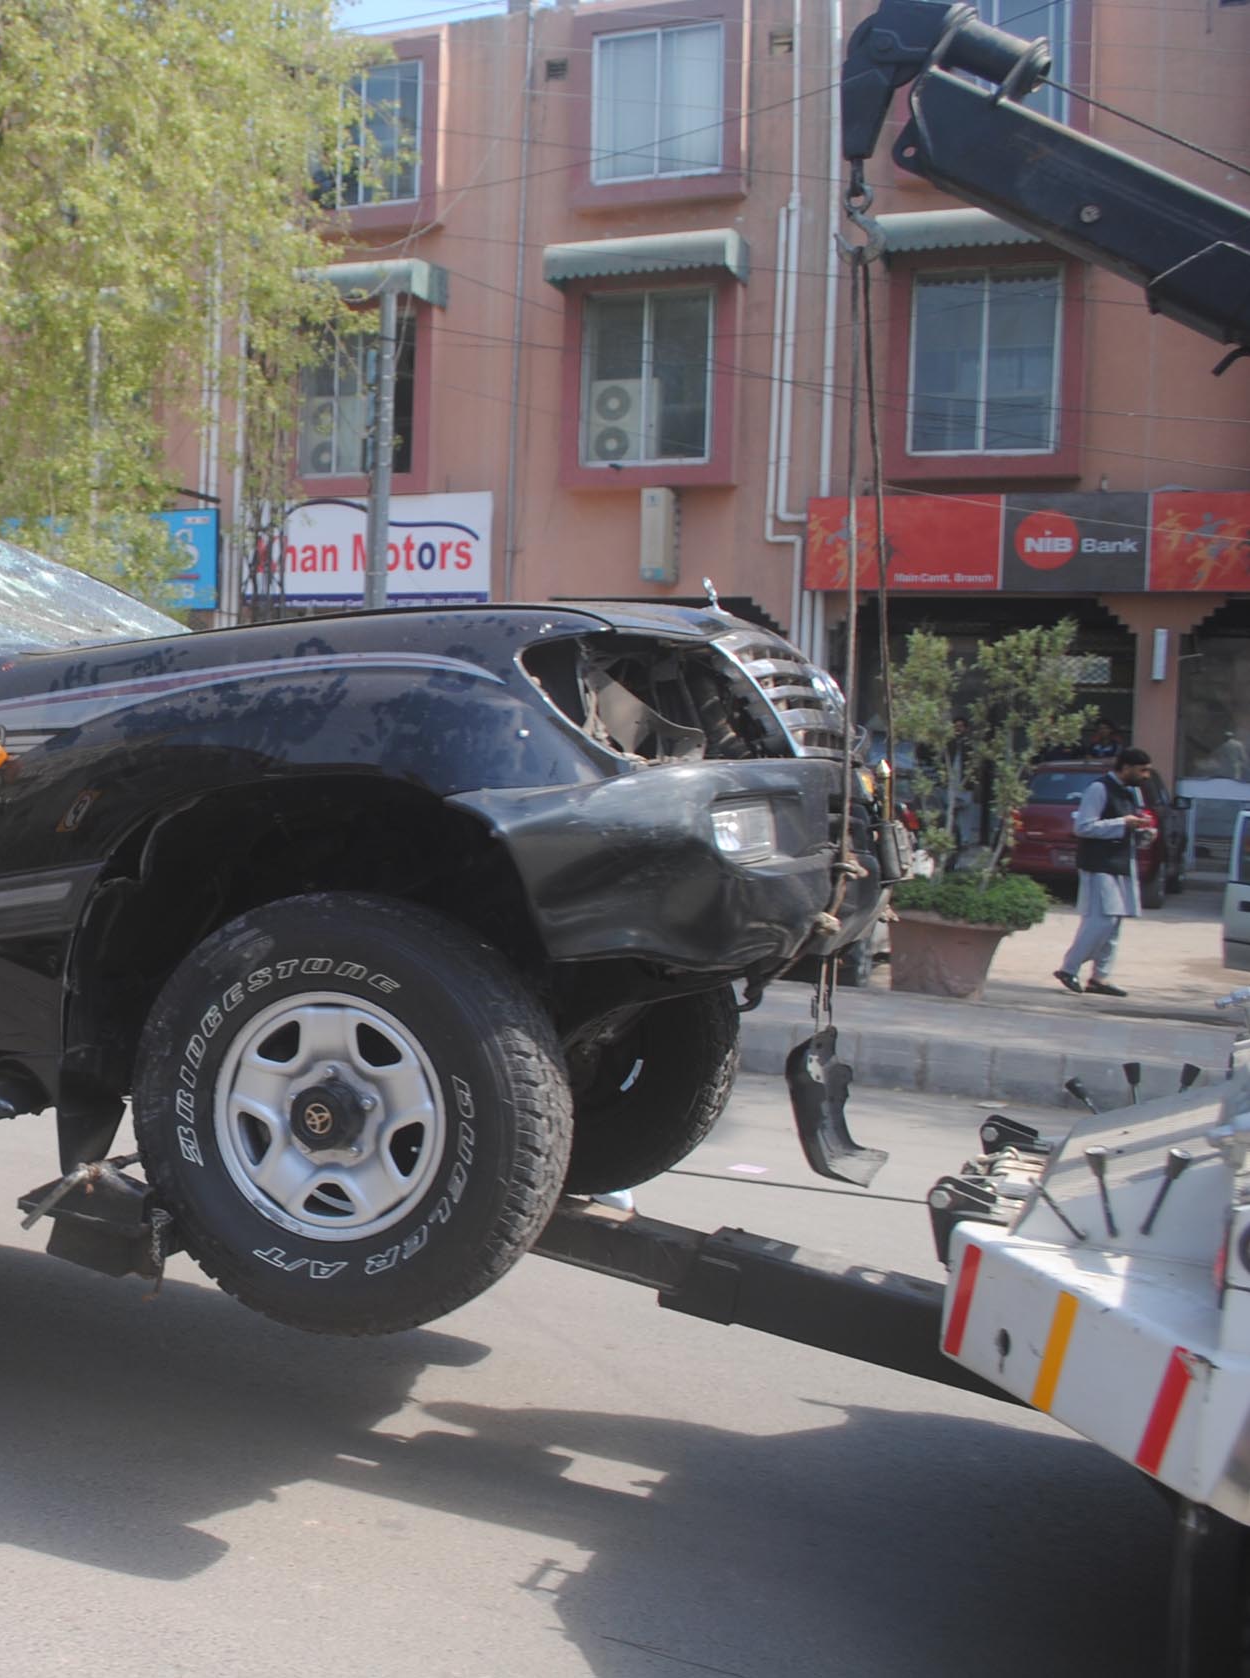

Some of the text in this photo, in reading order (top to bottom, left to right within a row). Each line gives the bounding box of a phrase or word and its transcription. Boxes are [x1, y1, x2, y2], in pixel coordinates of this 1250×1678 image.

[1080, 538, 1139, 554] Bank
[175, 957, 402, 1168] BRIDGESTONE
[251, 1074, 476, 1280] DUELER A/T
